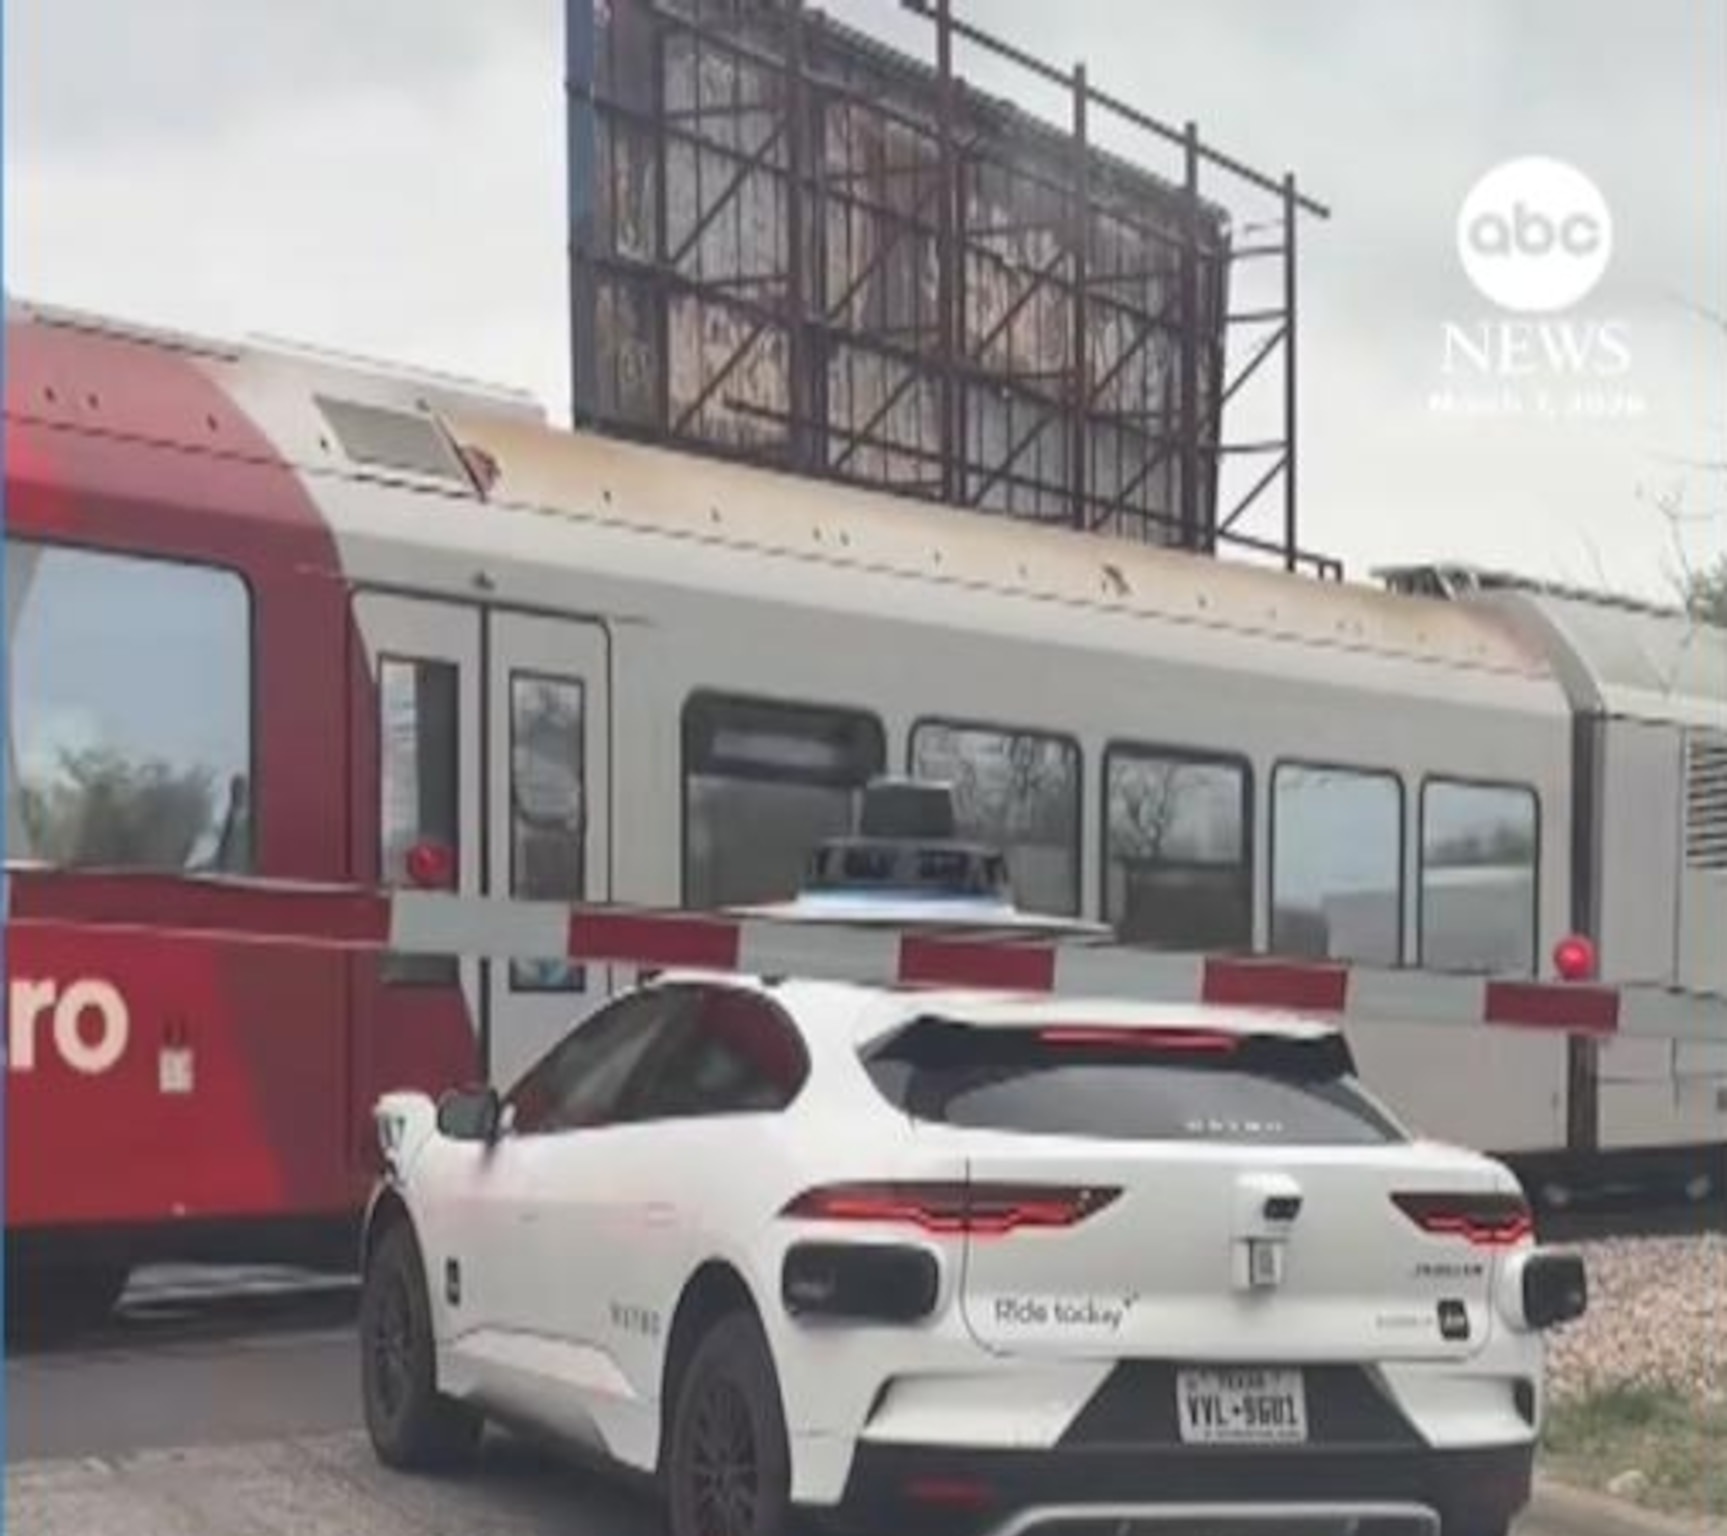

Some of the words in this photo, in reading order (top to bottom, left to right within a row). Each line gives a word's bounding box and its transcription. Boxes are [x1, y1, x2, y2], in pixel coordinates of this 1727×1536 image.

[9, 978, 130, 1076] ro
[995, 1299, 1048, 1325] Ride
[1053, 1296, 1124, 1330] today
